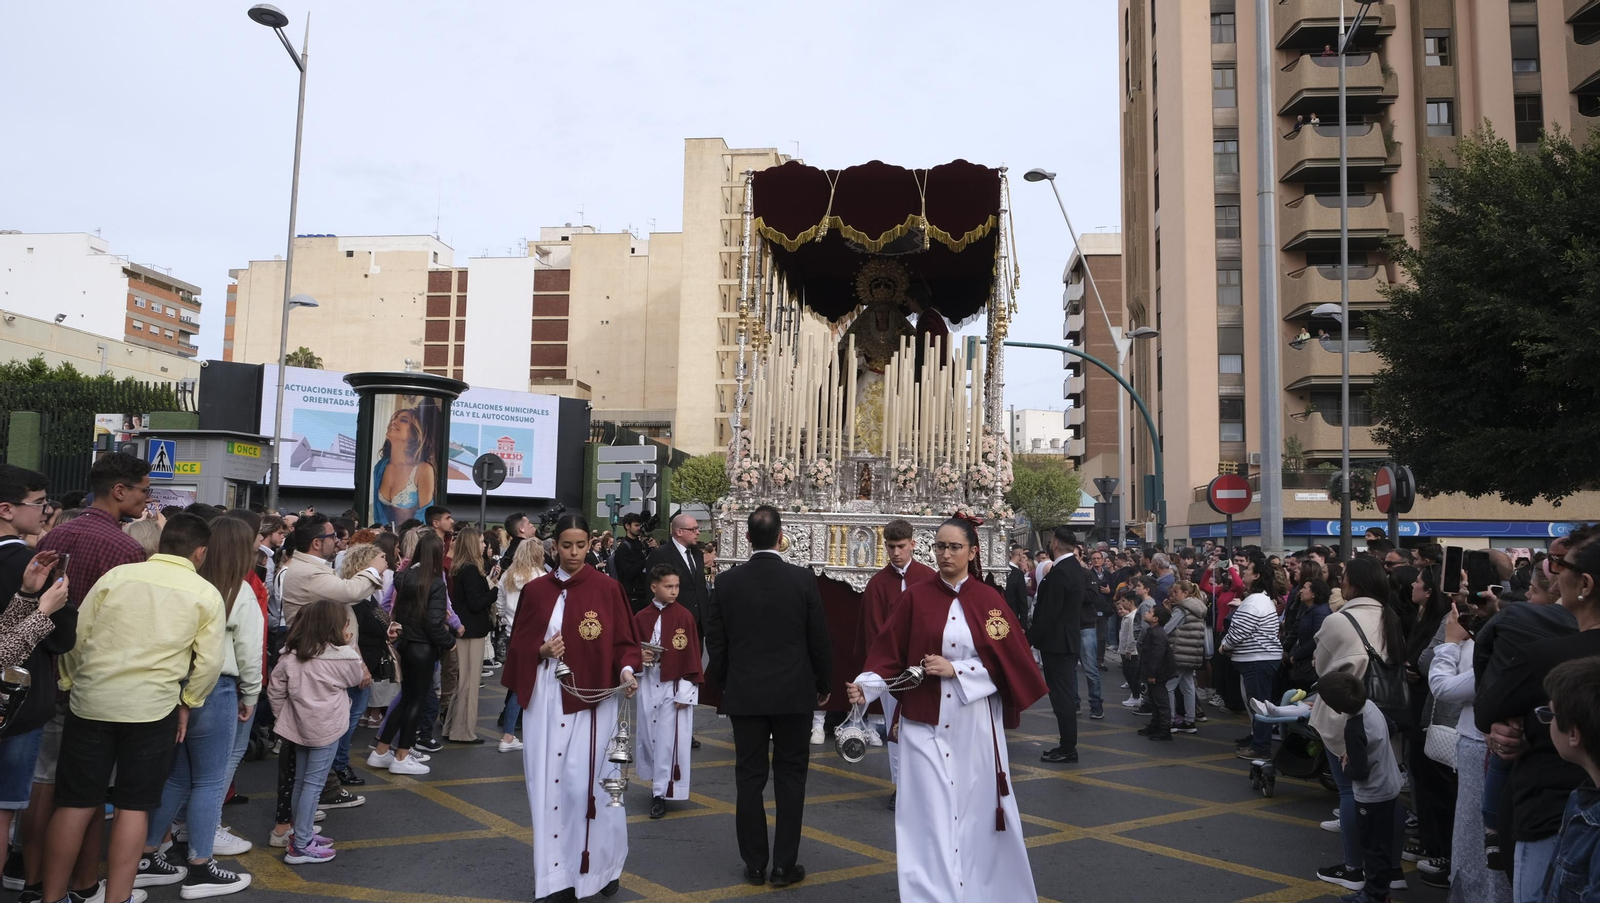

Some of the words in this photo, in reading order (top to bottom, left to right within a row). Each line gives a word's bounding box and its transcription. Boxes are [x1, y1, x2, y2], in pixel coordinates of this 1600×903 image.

[284, 384, 343, 396] ACTUACIONES
[344, 389, 356, 397] EN
[450, 400, 503, 412] NSTALACIONES
[504, 405, 550, 416] MUNICIPALES
[302, 395, 355, 407] ORIENTADAS
[481, 412, 535, 424] AUTOCONSUMO
[236, 444, 258, 456] ONCE
[174, 463, 197, 473] NCE
